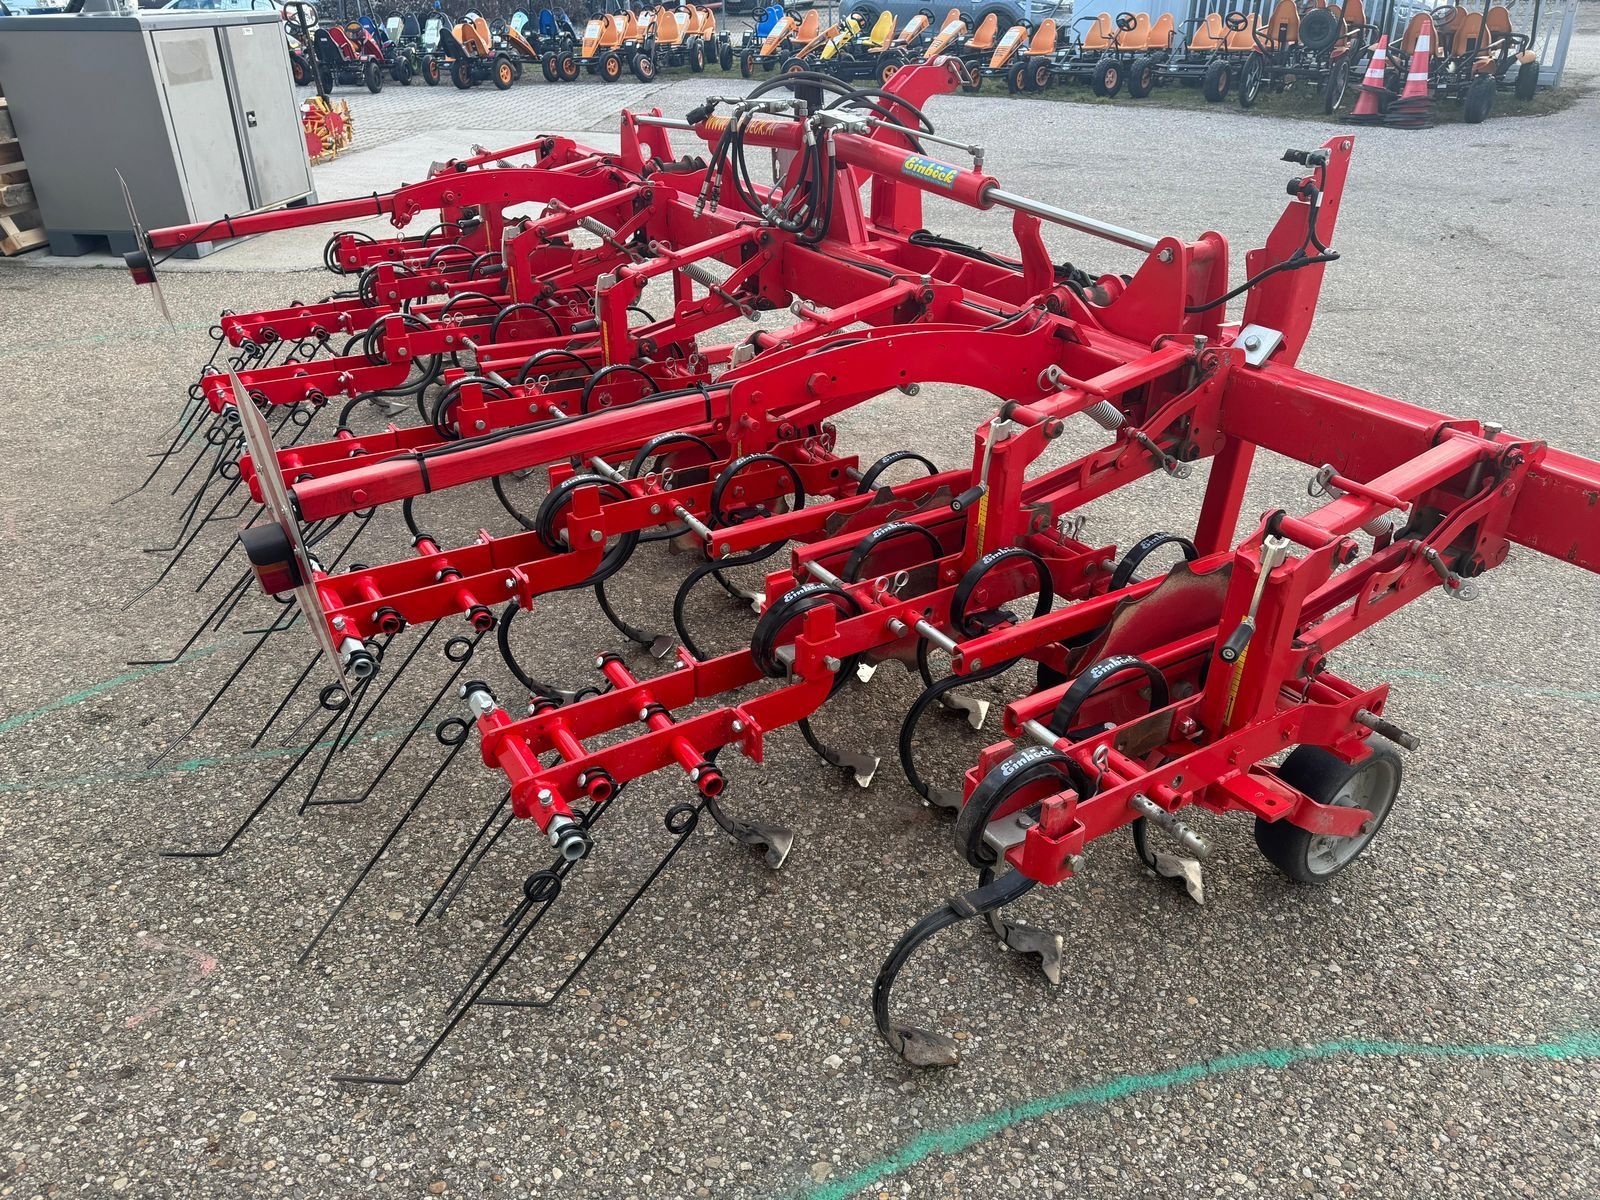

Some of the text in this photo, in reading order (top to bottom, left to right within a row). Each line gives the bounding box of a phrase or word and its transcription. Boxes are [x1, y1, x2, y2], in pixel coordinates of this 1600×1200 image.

[904, 156, 958, 183] Einböck
[1090, 655, 1139, 678] Einböck
[1000, 746, 1054, 777] Einböck
